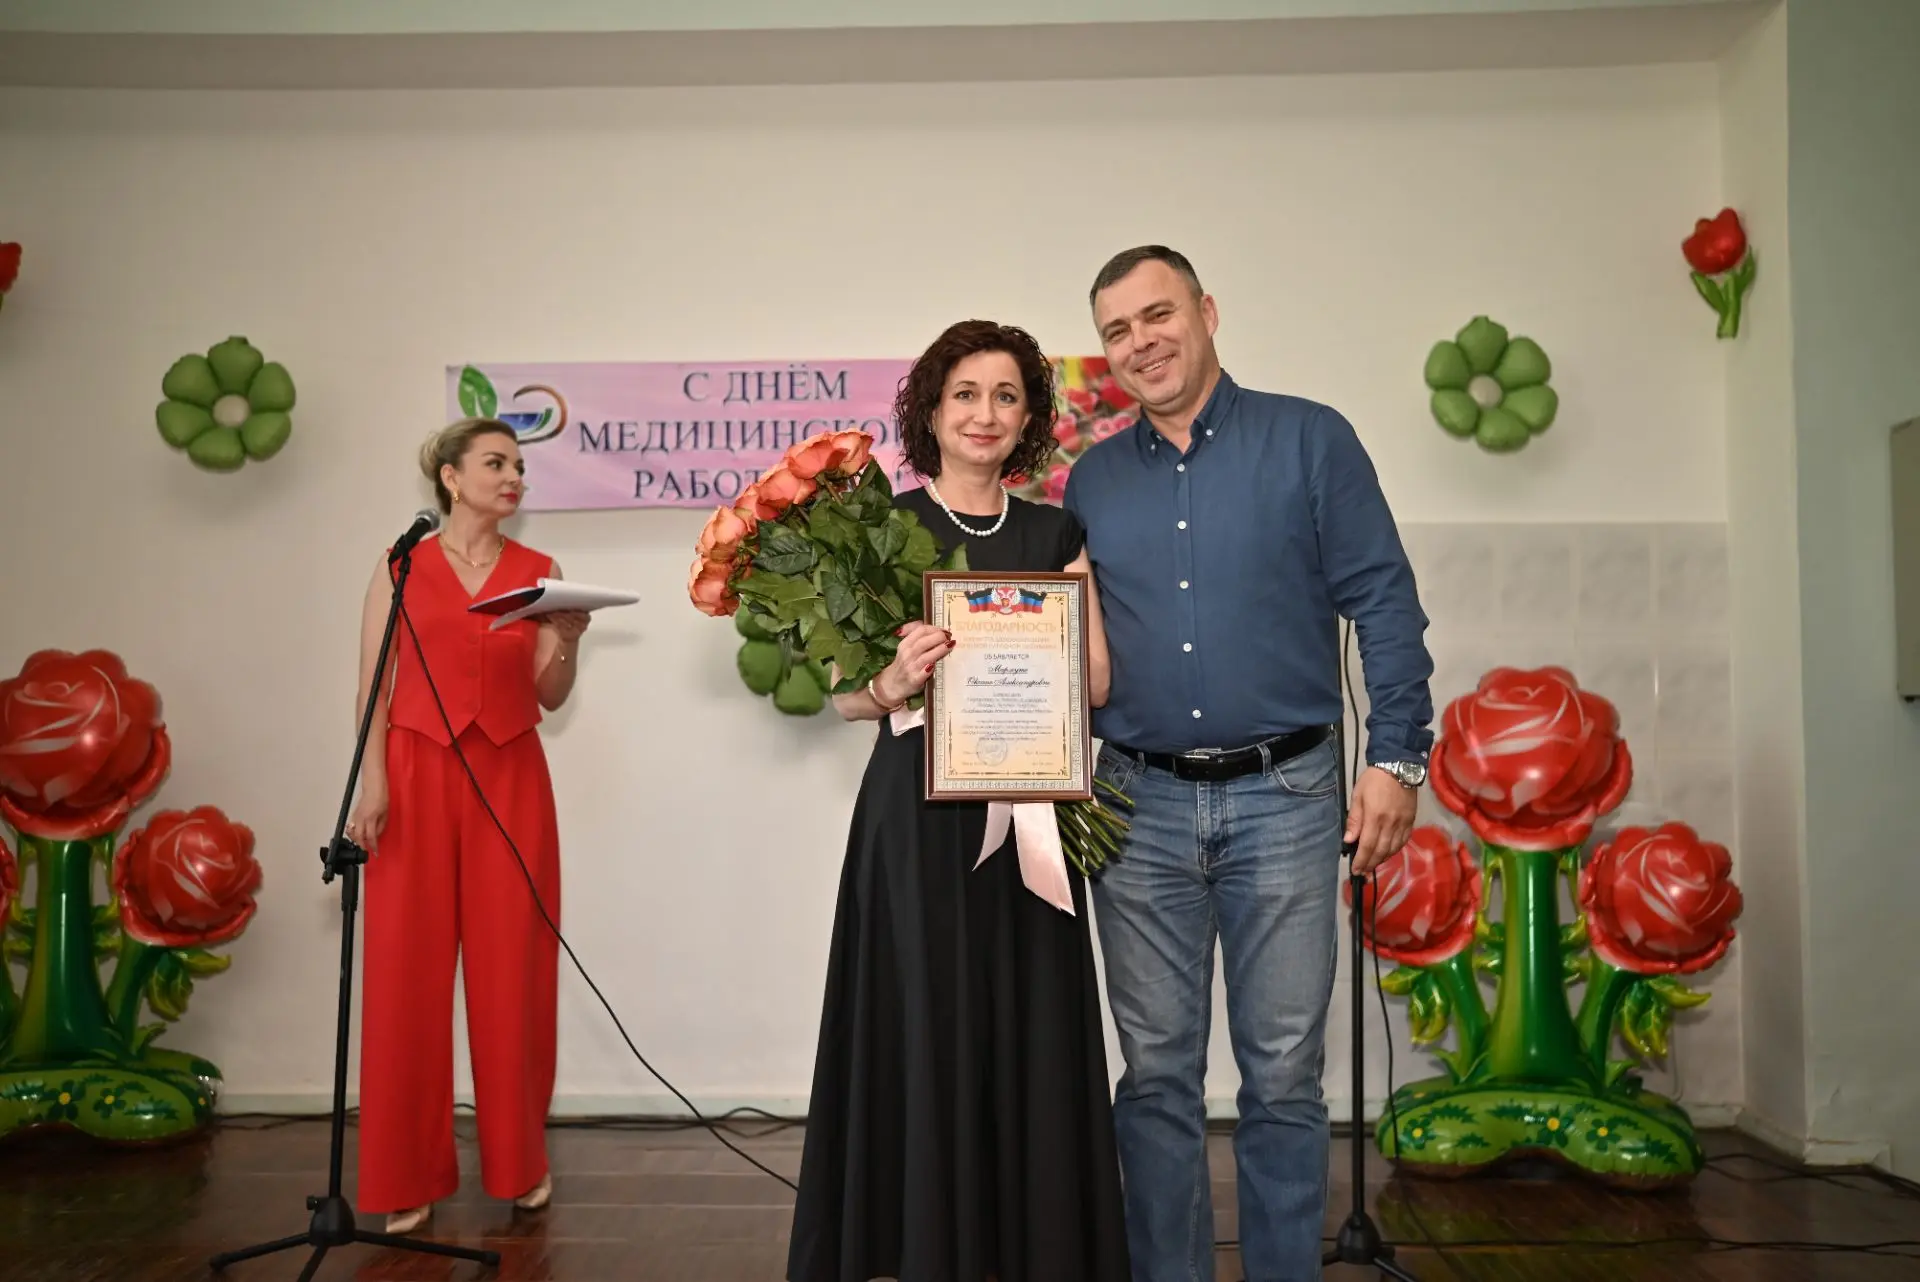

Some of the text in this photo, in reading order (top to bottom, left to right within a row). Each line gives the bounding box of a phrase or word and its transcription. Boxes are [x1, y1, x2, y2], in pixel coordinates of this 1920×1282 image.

[682, 363, 850, 406] С ДНЁМ
[956, 621, 1056, 633] БЛАГОДАРНОСТЬ
